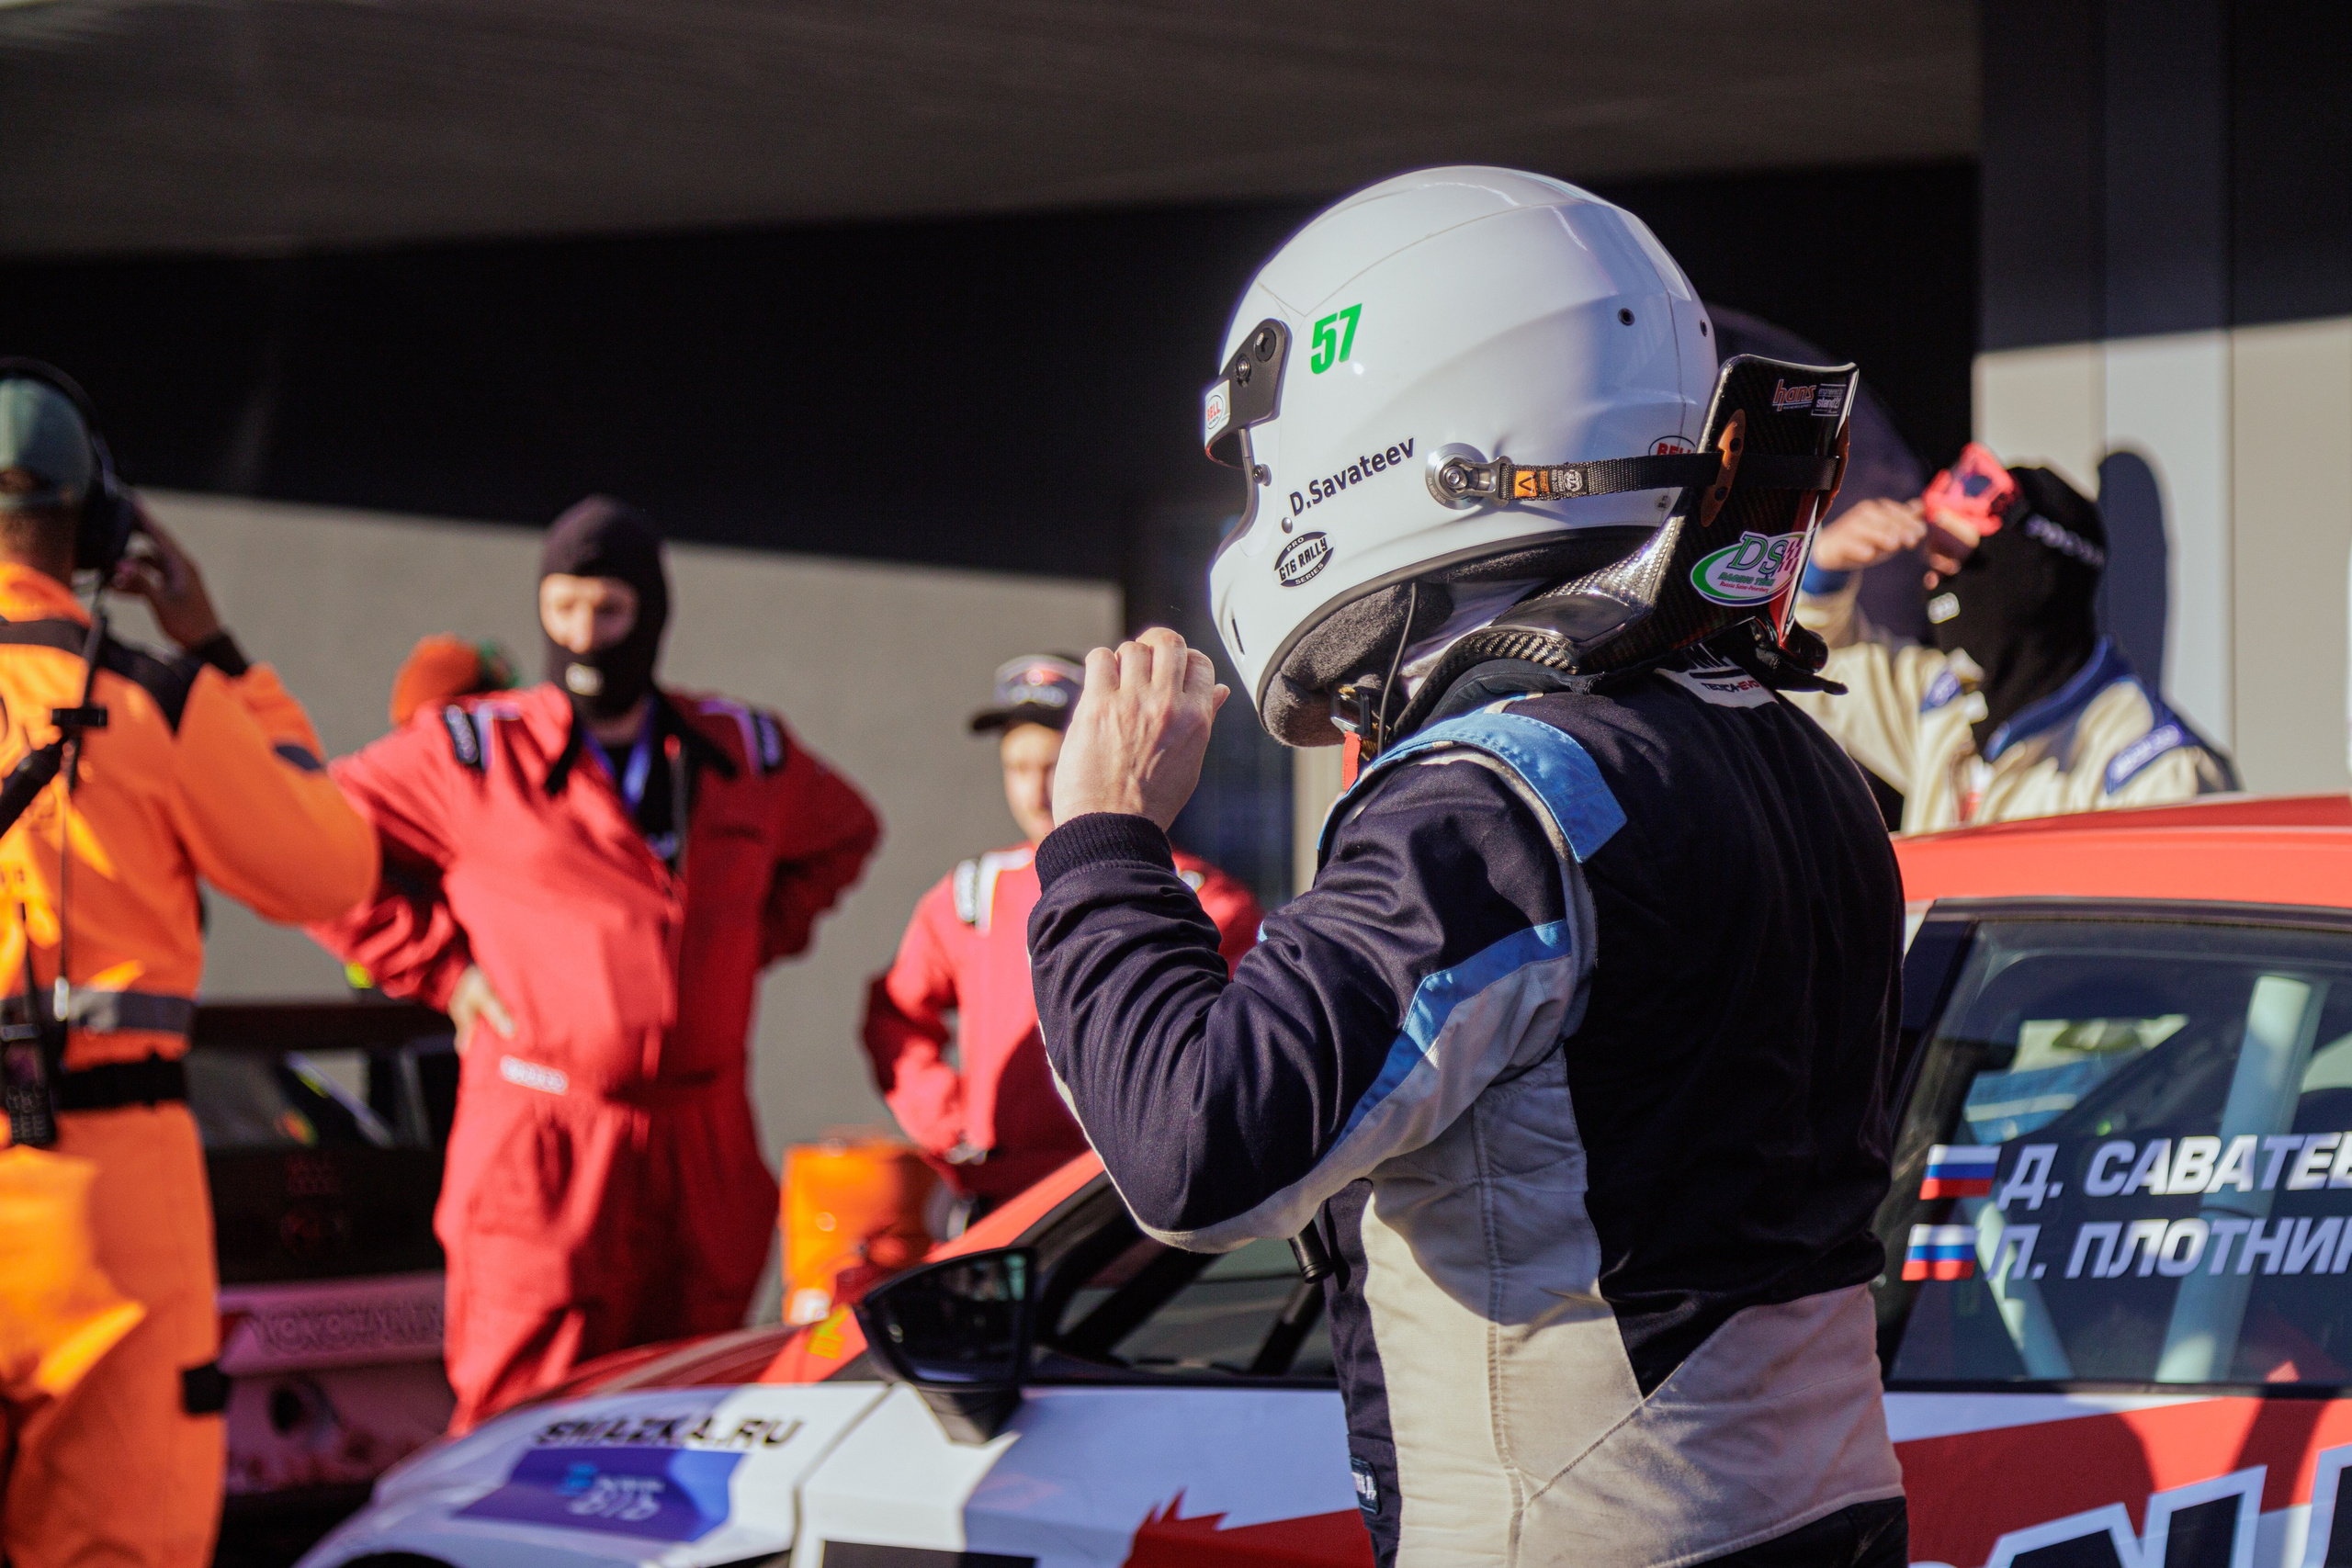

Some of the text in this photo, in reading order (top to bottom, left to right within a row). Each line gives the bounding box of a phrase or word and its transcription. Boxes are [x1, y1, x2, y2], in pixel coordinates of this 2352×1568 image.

[1310, 302, 1363, 375] 57
[1206, 400, 1221, 423] BELL
[1772, 378, 1816, 412] hans
[1288, 436, 1416, 517] D.Savateev
[1286, 536, 1305, 552] PRO
[1297, 536, 1329, 568] RALLY
[1726, 534, 1790, 575] DS
[1295, 562, 1324, 585] SERIES
[1996, 1142, 2064, 1212] Д.
[1984, 1224, 2048, 1280] П.
